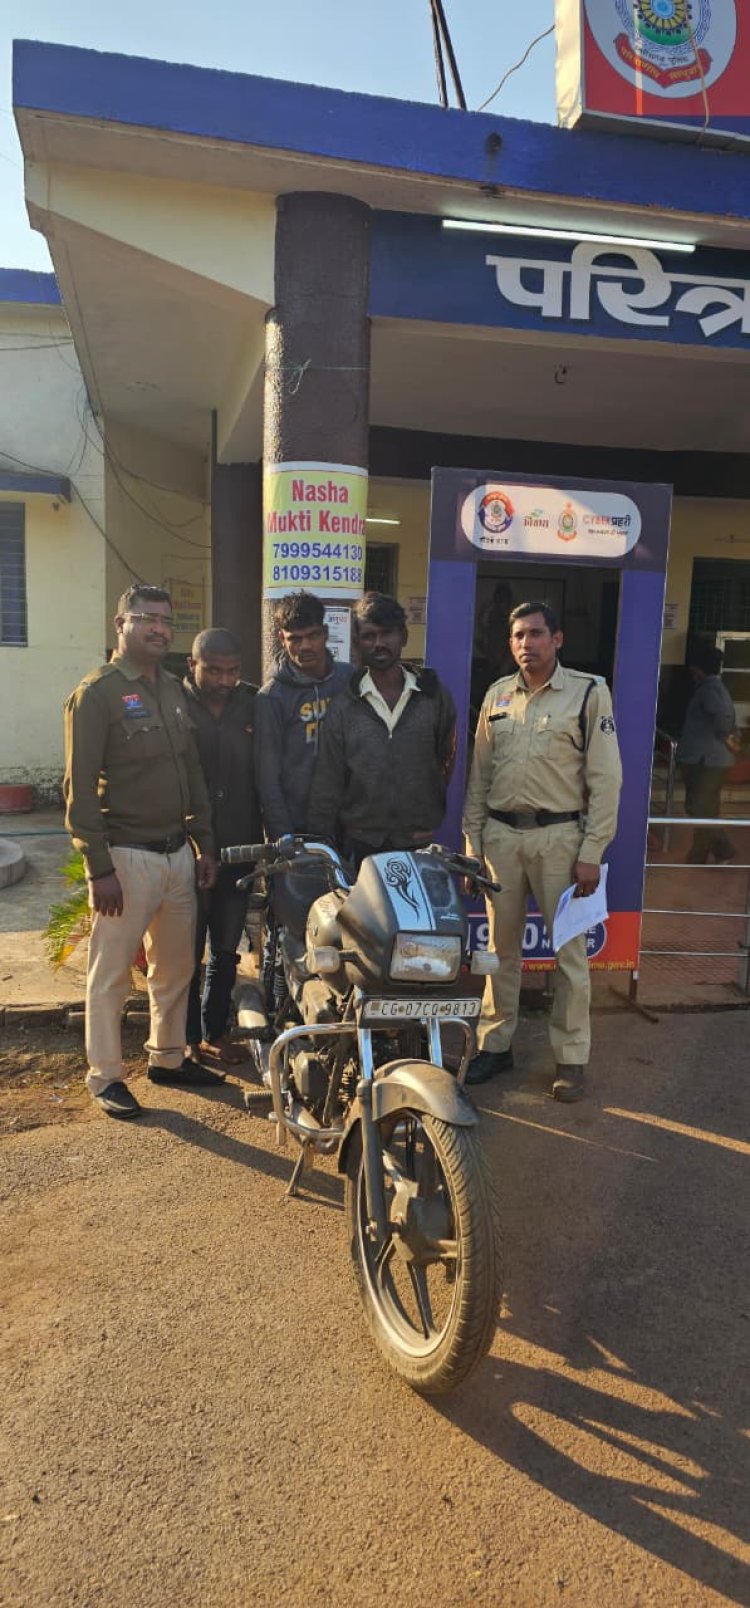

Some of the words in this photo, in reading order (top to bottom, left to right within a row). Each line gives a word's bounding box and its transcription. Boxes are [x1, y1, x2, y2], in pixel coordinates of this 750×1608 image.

[291, 479, 348, 503] Nasha
[268, 510, 312, 533] Mukti
[318, 510, 367, 536] Kendra
[273, 543, 362, 560] 7999544130
[273, 565, 362, 582] 8109315188
[381, 1003, 398, 1016] CG
